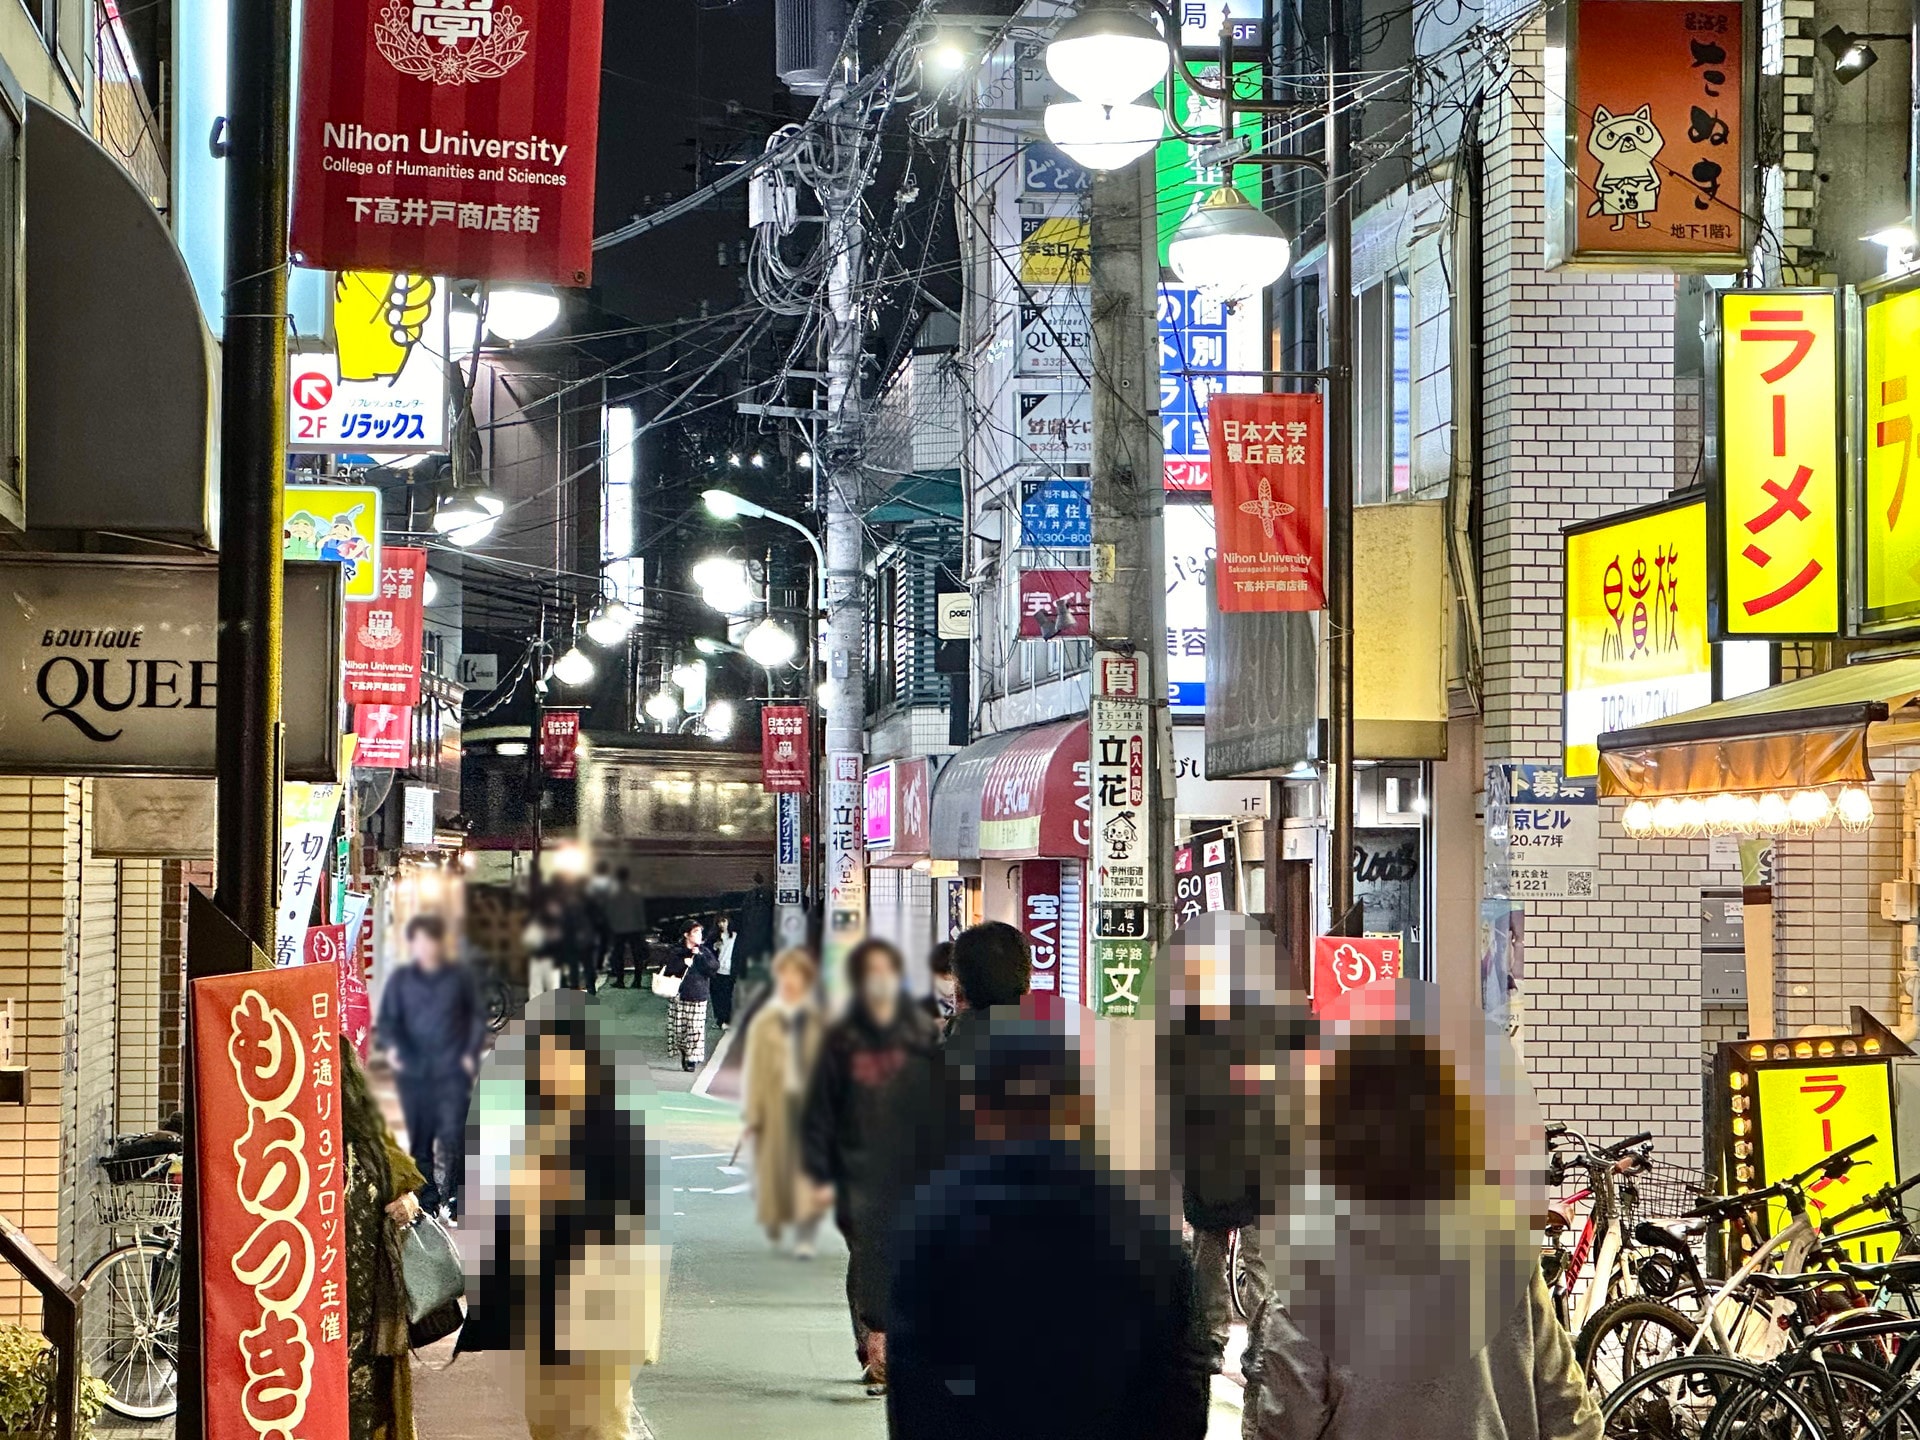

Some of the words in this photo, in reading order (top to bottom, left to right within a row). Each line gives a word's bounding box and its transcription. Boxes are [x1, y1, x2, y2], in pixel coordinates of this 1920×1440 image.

[1232, 25, 1257, 39] 5F
[322, 122, 409, 153] Nihon
[420, 130, 569, 166] University
[322, 156, 374, 175] College
[377, 158, 392, 175] of
[395, 161, 475, 180] Humanities
[478, 165, 504, 182] and
[508, 167, 567, 187] Sciences
[346, 196, 540, 233] 下高井戸商店街
[1023, 222, 1038, 232] 2F
[1671, 224, 1724, 240] 地下1階
[1023, 309, 1038, 320] 1F
[1023, 398, 1037, 408] 1F
[298, 416, 328, 438] 2F
[340, 413, 425, 439] リラックス
[1222, 420, 1308, 443] 日本大学
[1226, 444, 1306, 465] 櫻丘高校
[1741, 310, 1823, 616] ラーメン
[1024, 484, 1037, 494] 1F
[1222, 552, 1256, 564] Nihon
[1259, 553, 1313, 567] University
[1233, 580, 1308, 594] 下高井戸商店街
[41, 629, 143, 649] BOUTIQUE
[1098, 735, 1127, 807] 立花
[1240, 798, 1261, 811] 1F
[833, 805, 852, 850] 立花
[1511, 870, 1549, 879] 株式会社
[1027, 894, 1060, 970] 宝くじ
[1103, 922, 1135, 934] 4-45
[1102, 947, 1142, 960] 通学路
[1380, 950, 1394, 980] 日大
[1104, 962, 1140, 1003] 文
[312, 993, 342, 1344] 日大通り3ブロック主催
[228, 989, 315, 1440] もちつき
